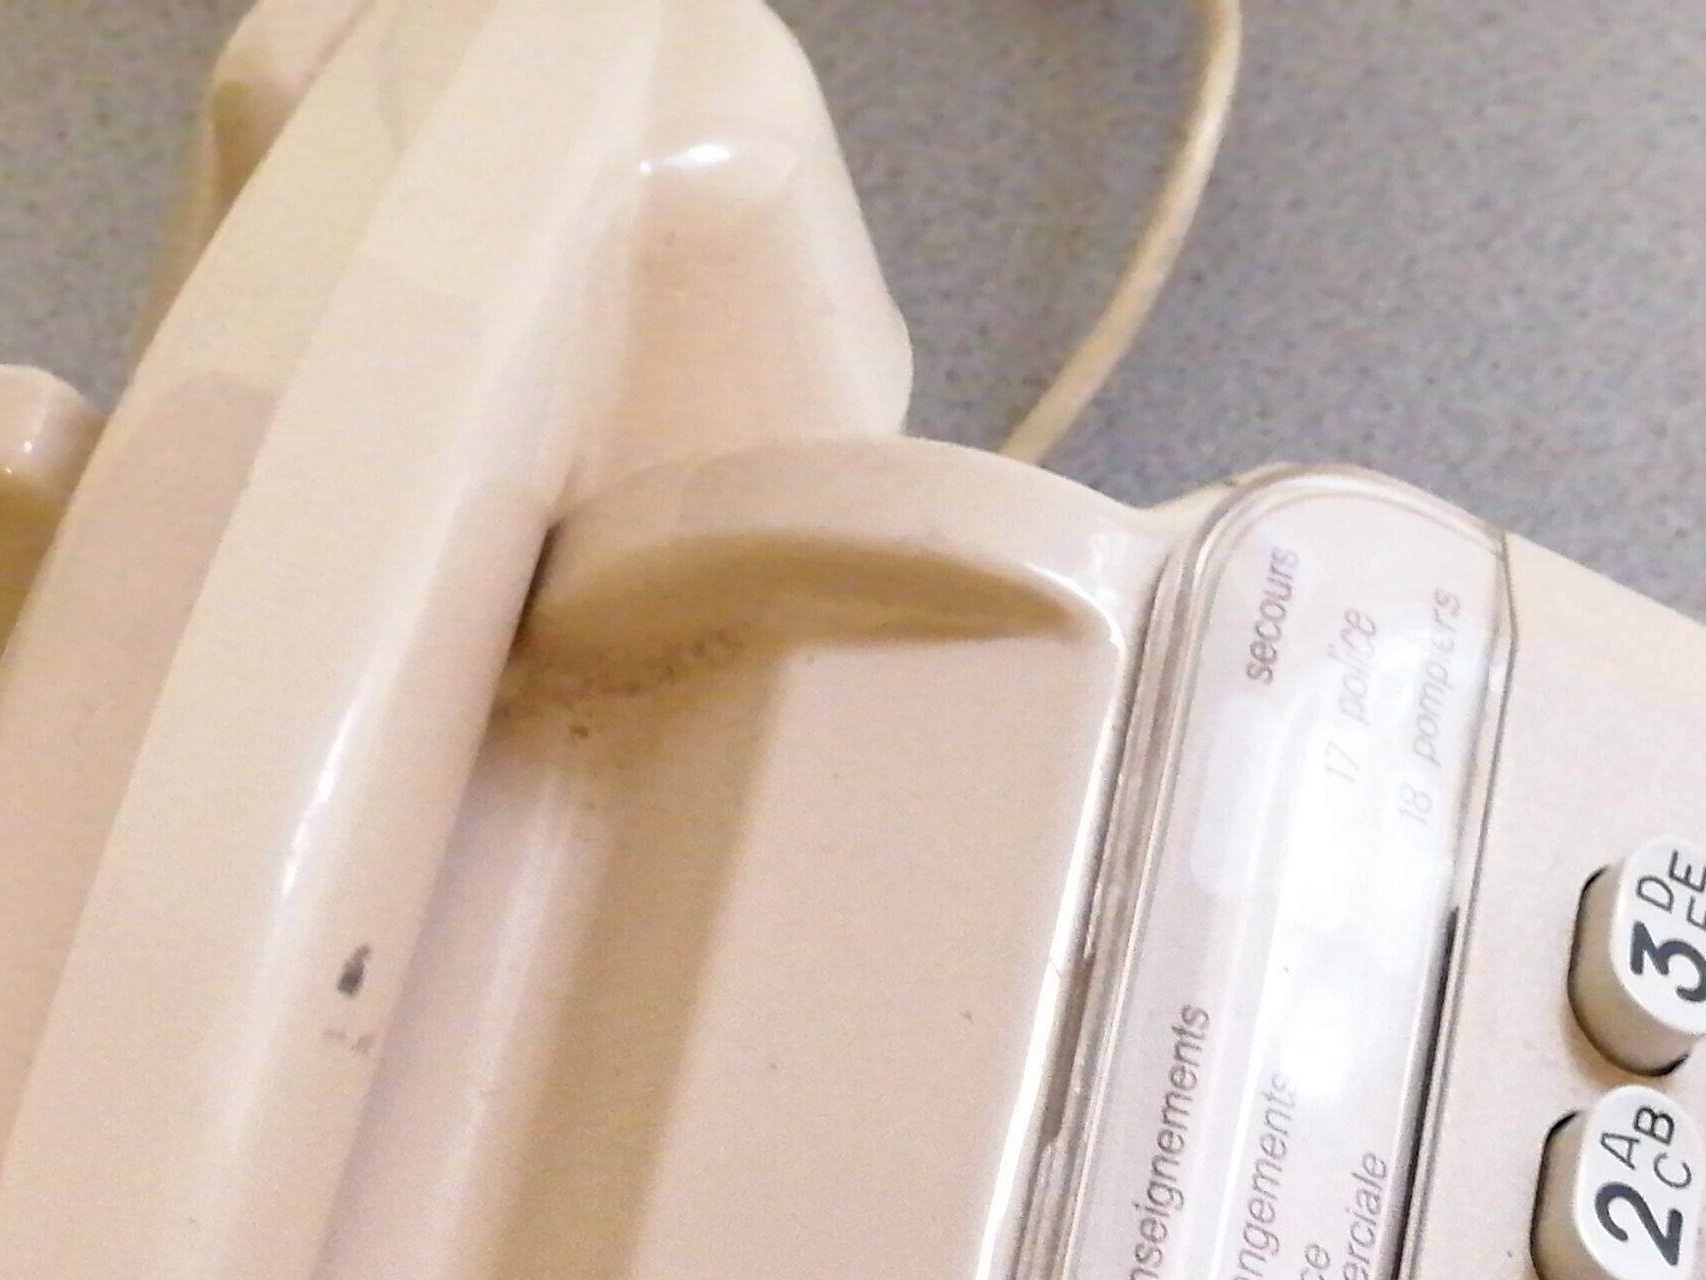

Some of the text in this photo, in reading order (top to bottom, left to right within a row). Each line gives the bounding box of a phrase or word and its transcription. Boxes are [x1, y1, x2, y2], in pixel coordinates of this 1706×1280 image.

[1245, 546, 1298, 686] secours
[1324, 607, 1379, 784] 17 police
[1397, 589, 1461, 827] 18 pompiers
[1594, 1182, 1684, 1267] 2
